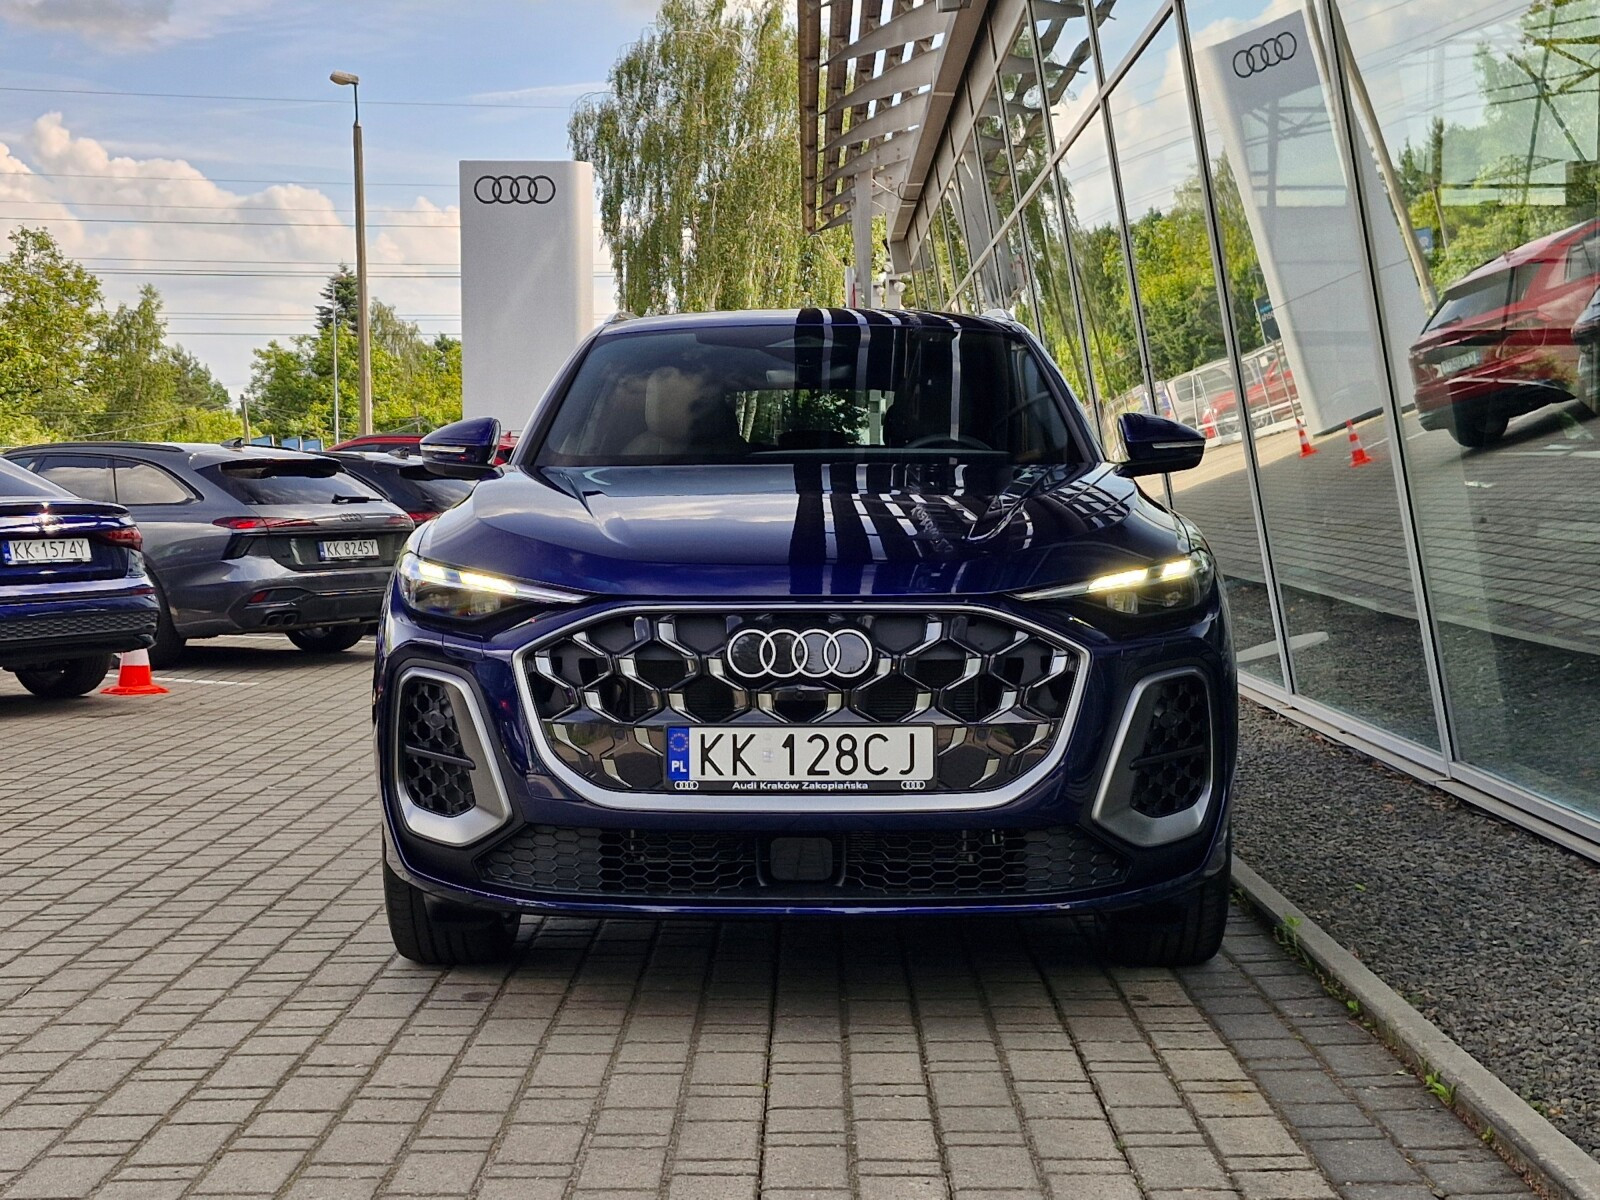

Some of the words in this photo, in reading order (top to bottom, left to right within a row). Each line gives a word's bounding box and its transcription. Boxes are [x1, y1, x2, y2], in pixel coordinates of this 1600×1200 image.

[13, 542, 35, 559] KK
[41, 541, 85, 558] 1574Y
[326, 542, 341, 556] KK
[344, 541, 375, 555] 8245Y
[700, 733, 756, 776] KK
[781, 733, 915, 776] 128CJ
[671, 760, 687, 773] PL
[732, 781, 757, 790] Audi
[760, 781, 799, 790] Kraków
[801, 781, 869, 792] Zakopiańska
